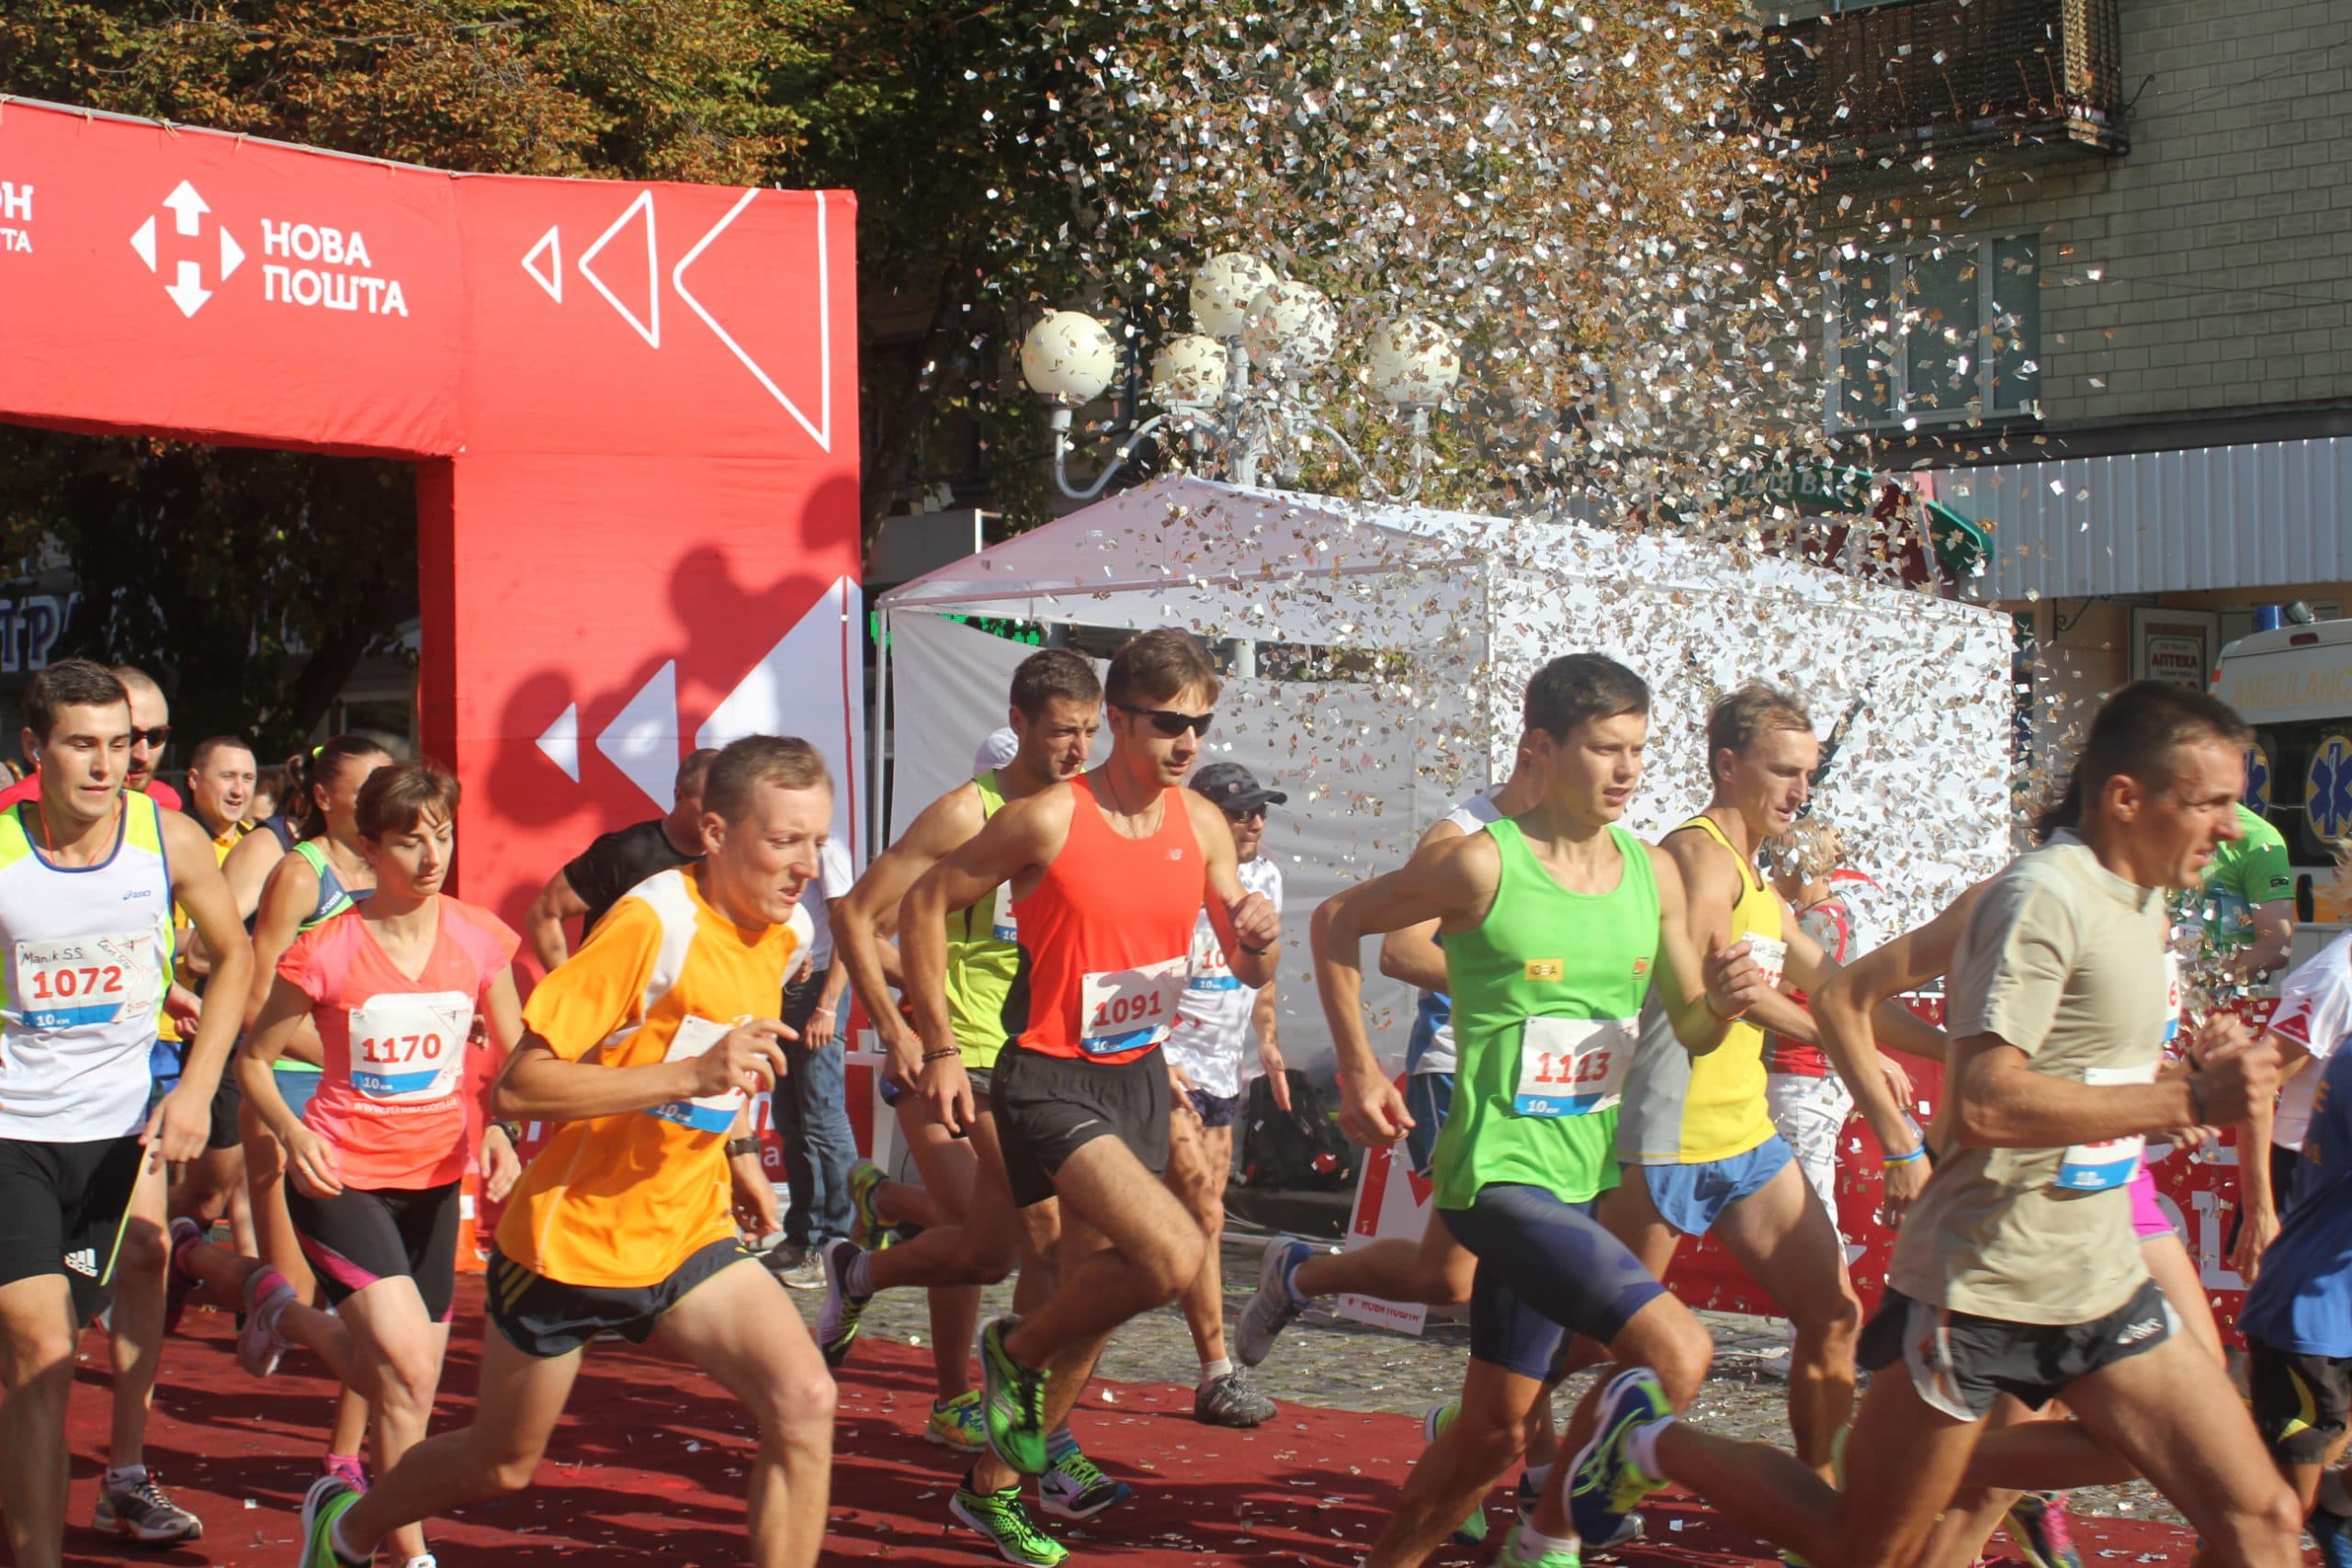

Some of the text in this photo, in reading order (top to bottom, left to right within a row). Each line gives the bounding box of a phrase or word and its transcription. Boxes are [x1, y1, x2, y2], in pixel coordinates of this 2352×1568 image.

[0, 181, 34, 221] Н
[260, 217, 373, 269] НОВА
[262, 263, 409, 318] ПОШТА
[2151, 652, 2199, 669] АПТЕКА
[1201, 949, 1228, 970] 10
[31, 965, 123, 999] 1072
[1093, 990, 1163, 1028] 1091
[361, 1032, 442, 1064] 1170
[1533, 1051, 1612, 1084] 1113
